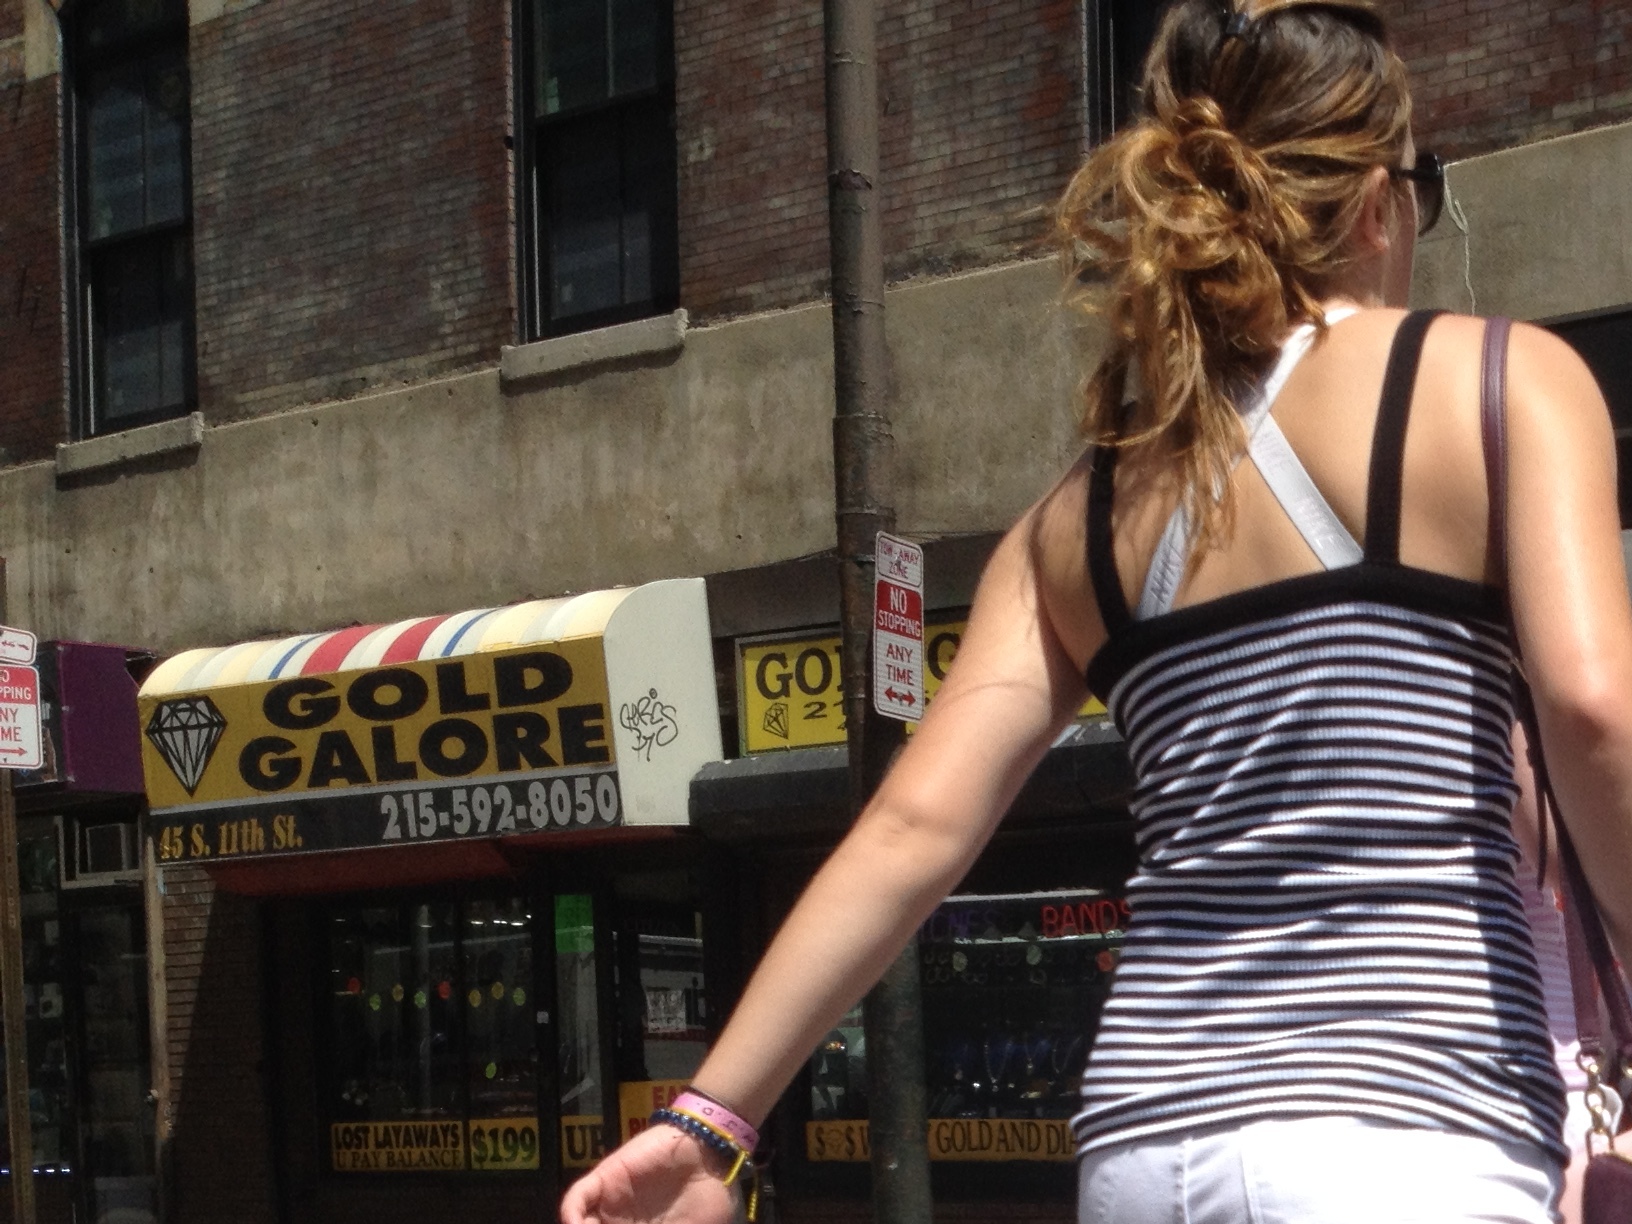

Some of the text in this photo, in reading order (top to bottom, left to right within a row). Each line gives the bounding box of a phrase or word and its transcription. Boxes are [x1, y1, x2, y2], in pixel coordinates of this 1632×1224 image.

[888, 562, 909, 580] ZONE
[890, 586, 908, 615] NO
[878, 609, 921, 637] STOPPING
[886, 642, 914, 664] ANY
[756, 648, 841, 701] GO
[886, 664, 915, 687] TIME
[263, 651, 574, 730] GOLD
[0, 707, 18, 723] NY
[1, 726, 22, 742] ME
[239, 703, 610, 792] GALORE
[380, 774, 619, 840] 215-592-8050
[160, 814, 303, 859] 45 S. 11th St.
[333, 1123, 460, 1150] LOST LAYAWAYS
[472, 1124, 536, 1165] $199
[936, 1121, 992, 1154] GOLD
[996, 1121, 1042, 1153] AND
[351, 1150, 382, 1169] PAY
[386, 1148, 462, 1168] BALANCE
